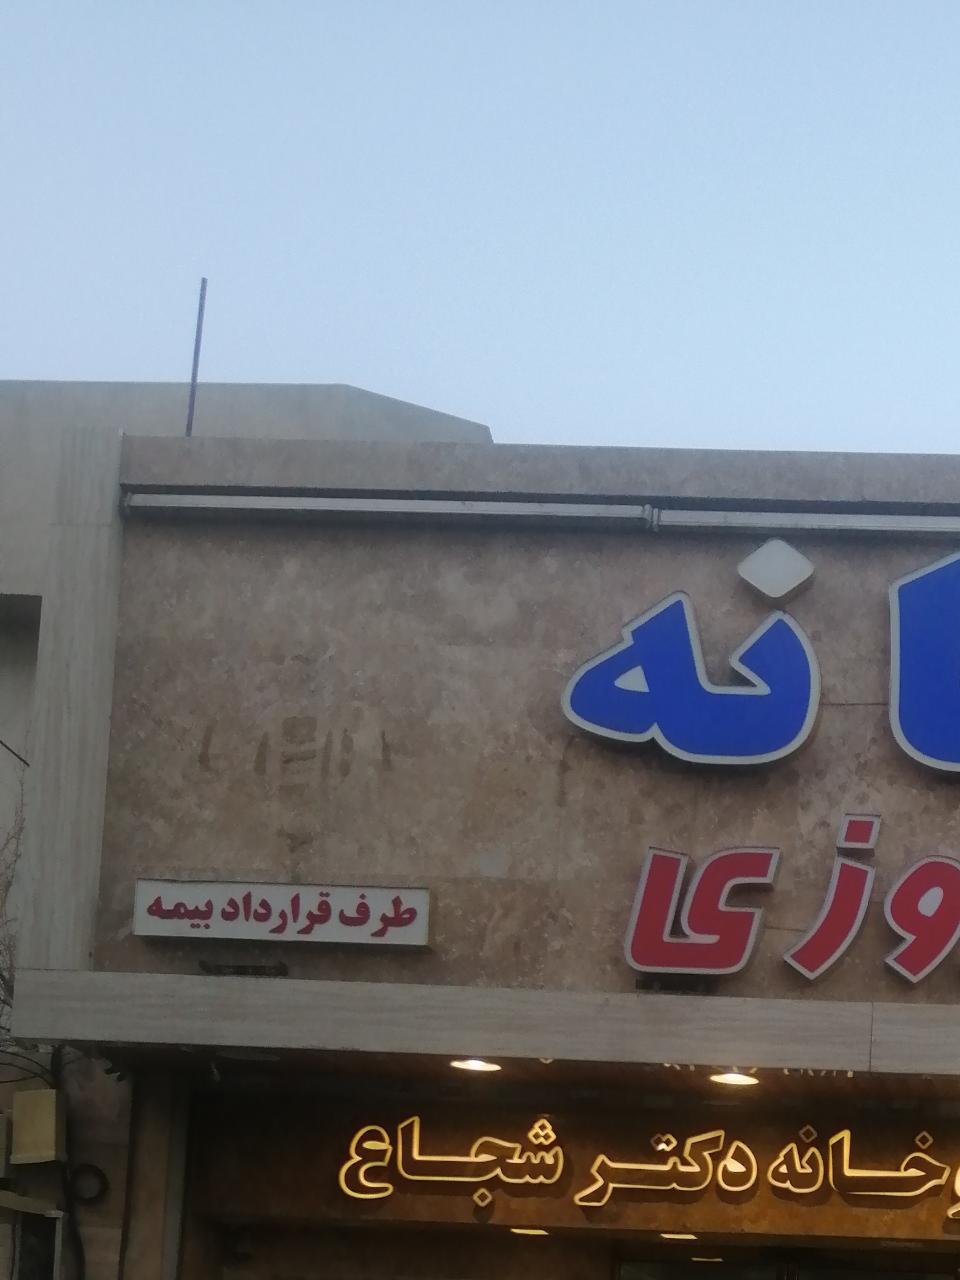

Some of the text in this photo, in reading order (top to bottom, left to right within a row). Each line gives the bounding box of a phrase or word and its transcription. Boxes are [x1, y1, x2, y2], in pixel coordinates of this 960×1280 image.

[147, 891, 418, 937] طرف قرارداد بیمه
[339, 1115, 565, 1209] شجاع
[573, 1129, 759, 1208] دکتر
